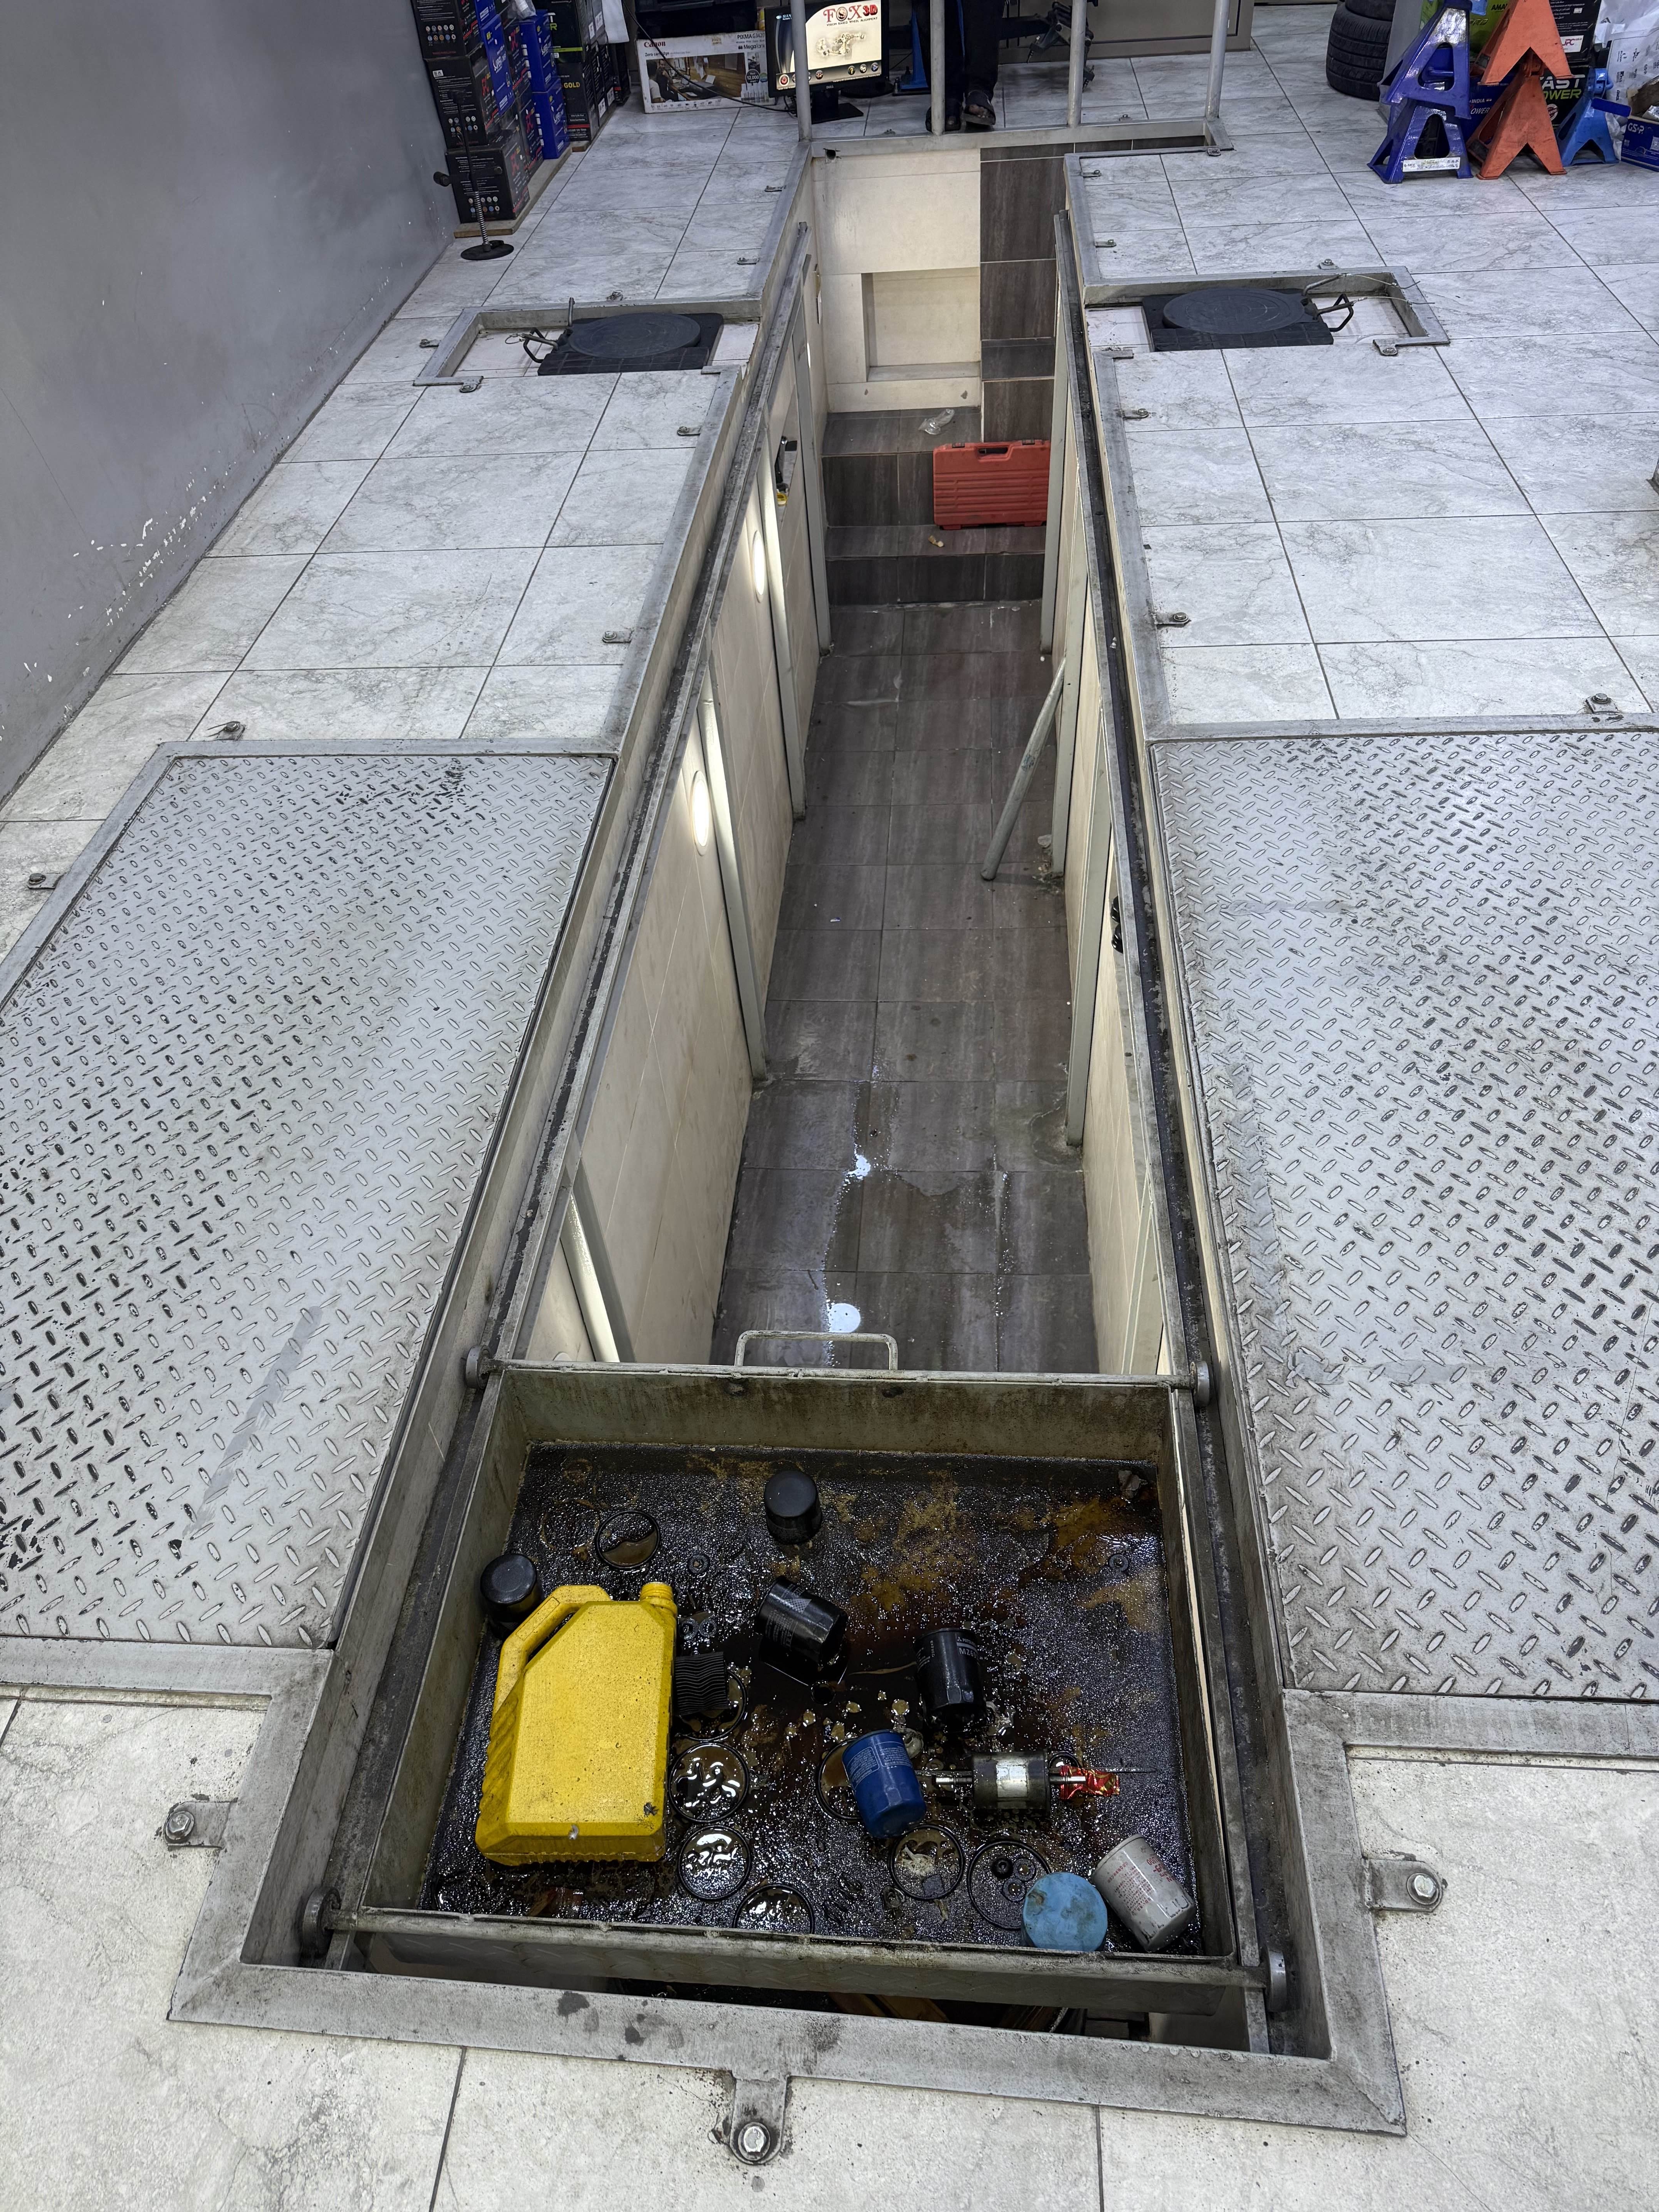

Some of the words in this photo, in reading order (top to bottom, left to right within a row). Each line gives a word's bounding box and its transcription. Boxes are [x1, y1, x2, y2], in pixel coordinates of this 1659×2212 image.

[863, 5, 878, 16] 3D
[1540, 74, 1585, 90] AST
[1543, 89, 1582, 100] OWER
